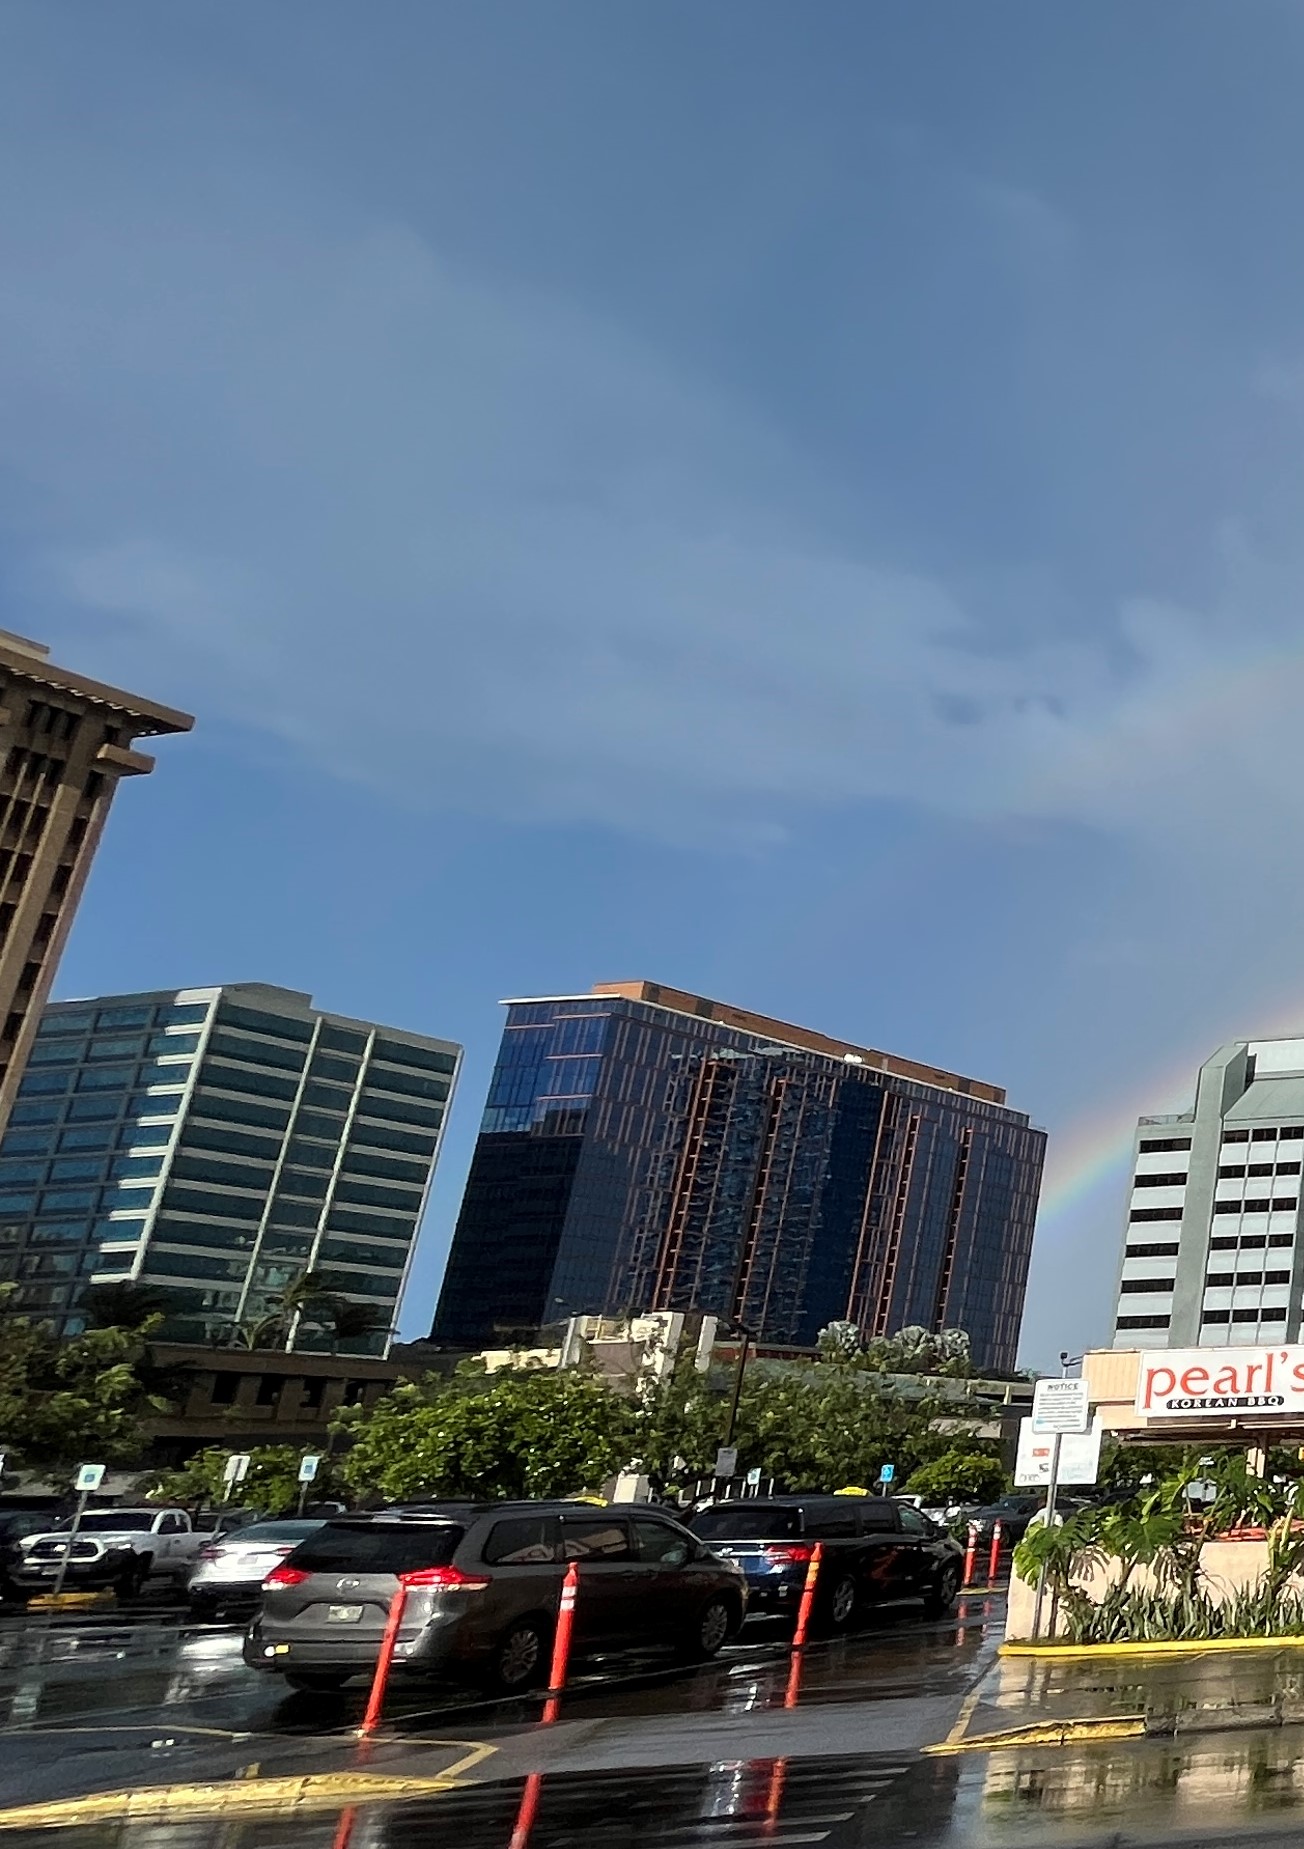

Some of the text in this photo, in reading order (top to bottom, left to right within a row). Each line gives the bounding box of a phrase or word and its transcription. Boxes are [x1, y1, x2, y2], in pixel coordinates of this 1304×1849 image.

[1047, 1382, 1079, 1391] NOTICE
[1171, 1395, 1280, 1409] KOREAN BBQ
